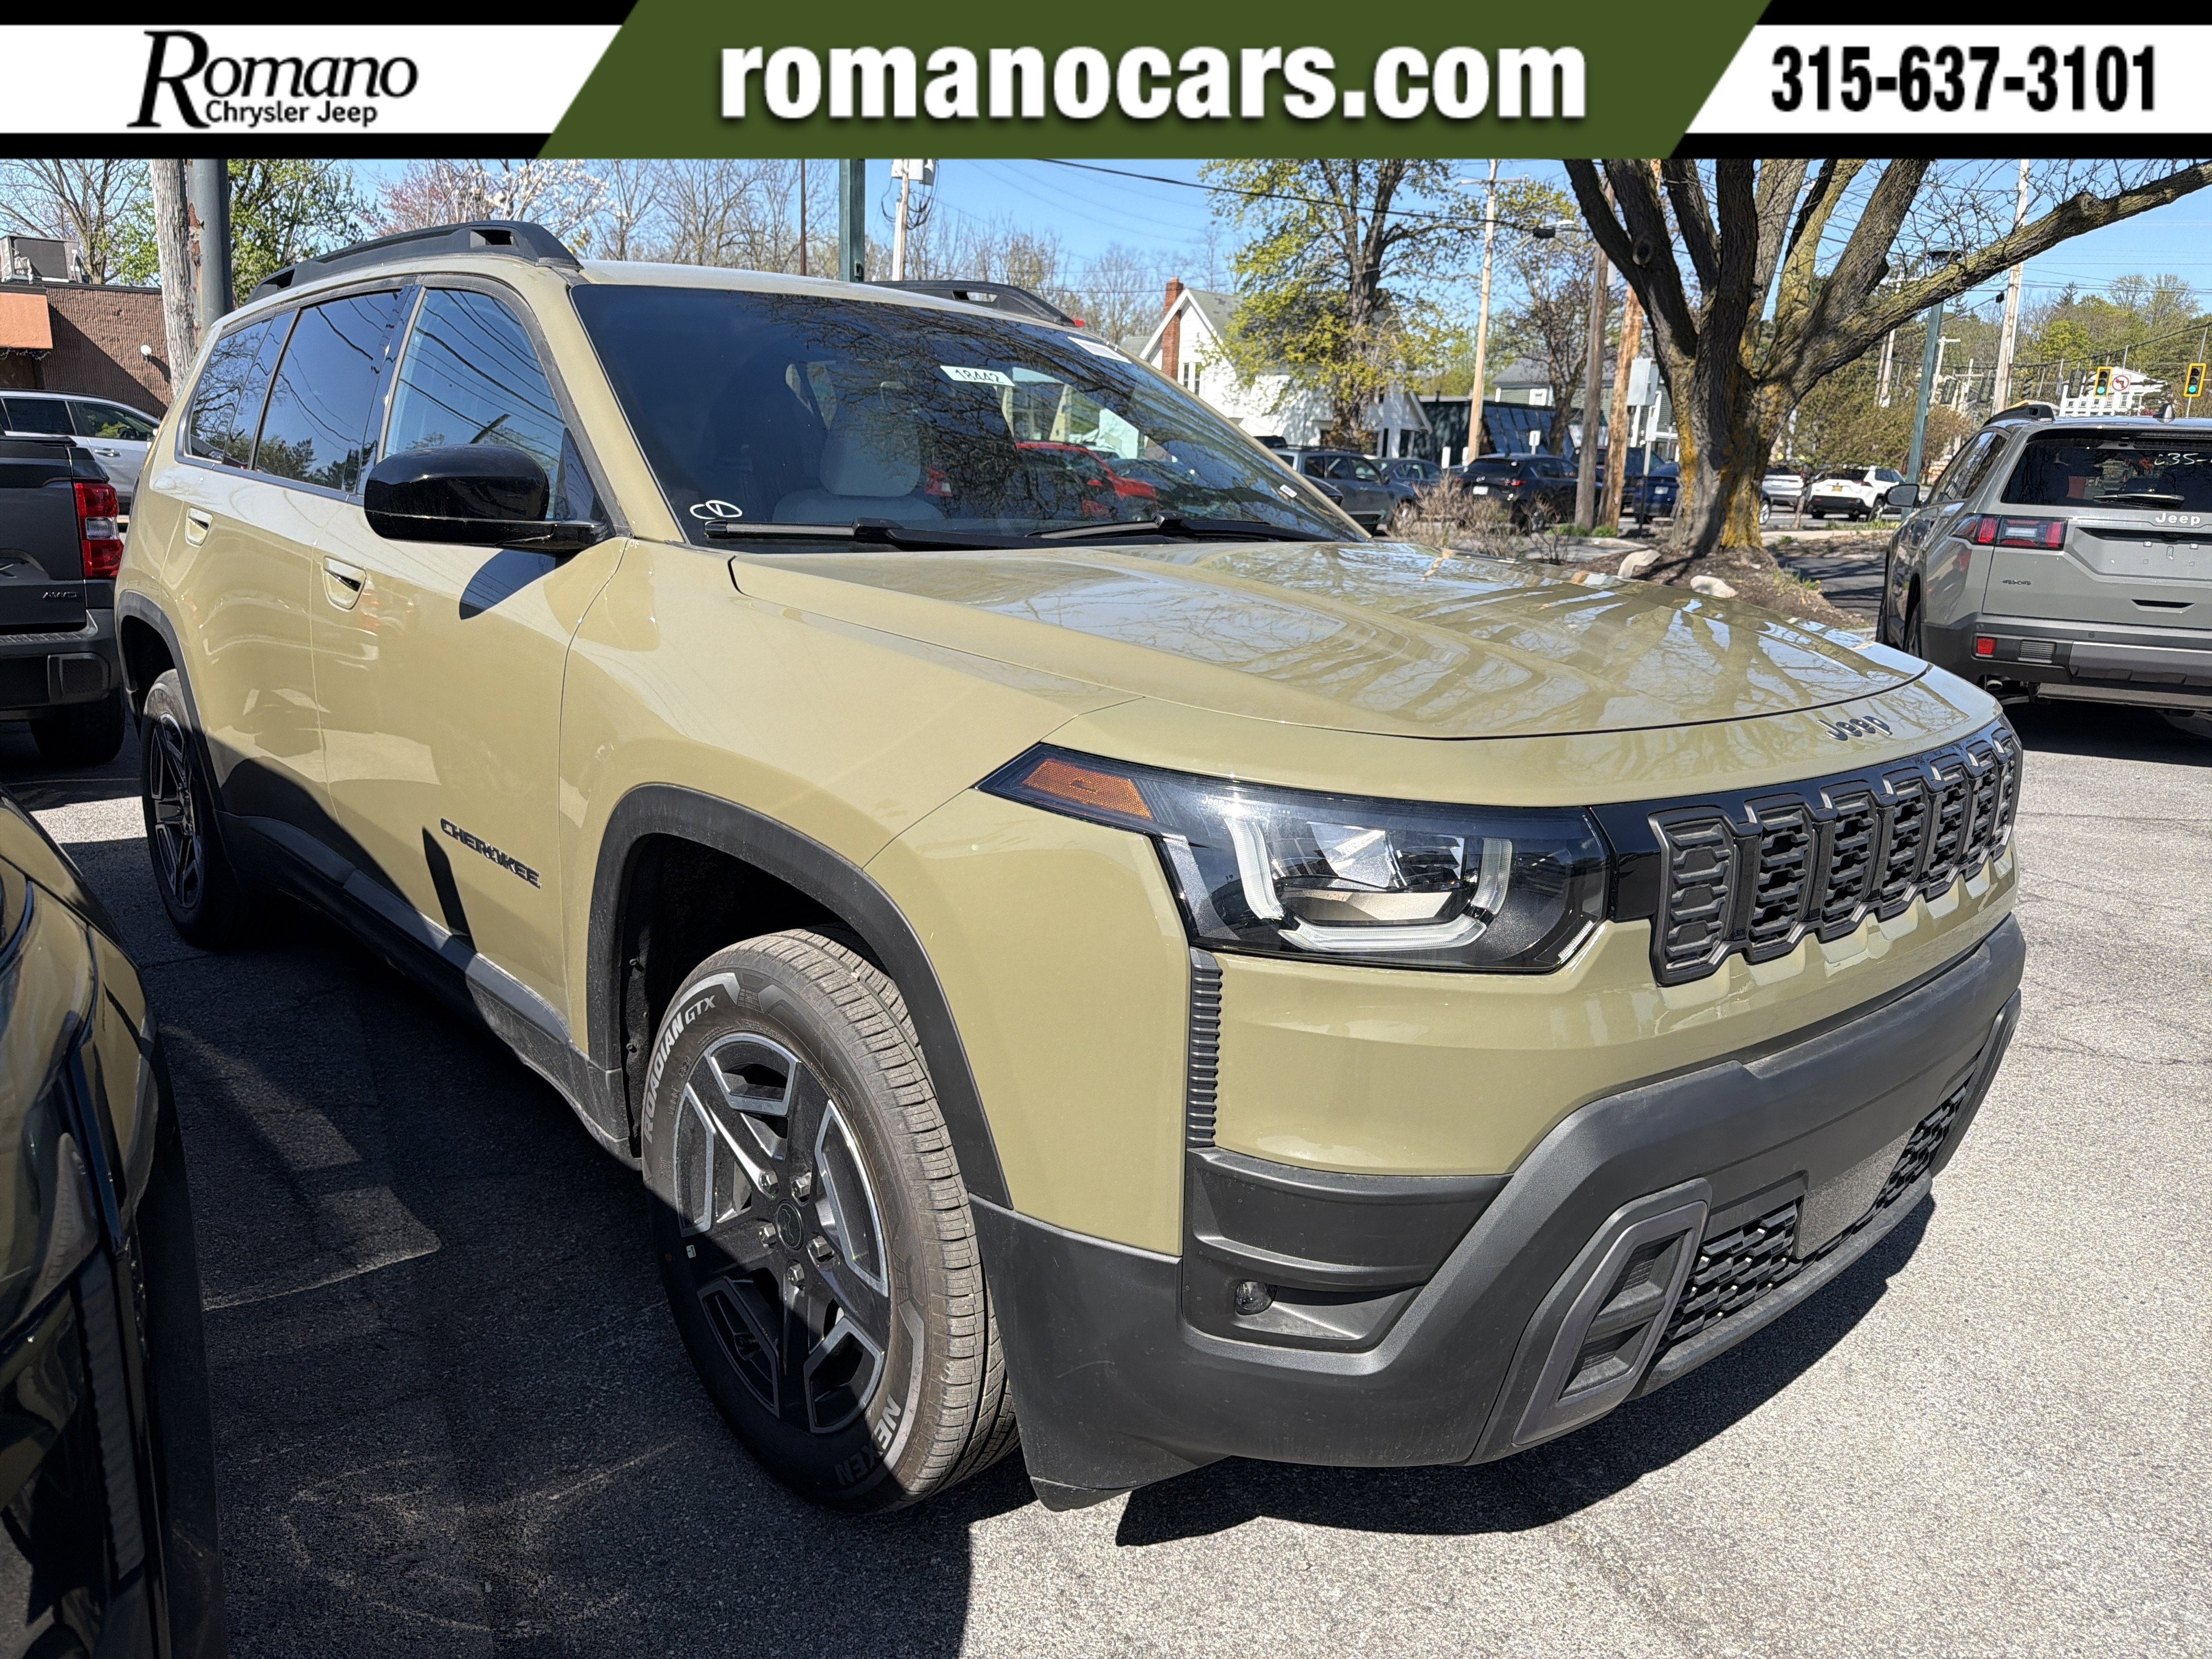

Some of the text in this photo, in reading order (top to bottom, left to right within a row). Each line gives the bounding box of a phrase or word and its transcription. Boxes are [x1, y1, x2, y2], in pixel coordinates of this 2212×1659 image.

[955, 369, 1005, 383] 18442
[2155, 512, 2200, 526] Jeep
[1816, 715, 1893, 741] Jeep
[441, 817, 541, 890] CHEROKEE
[644, 1012, 685, 1144] ROADIAN
[685, 995, 716, 1025] GTX
[833, 1393, 901, 1486] NEXEN
